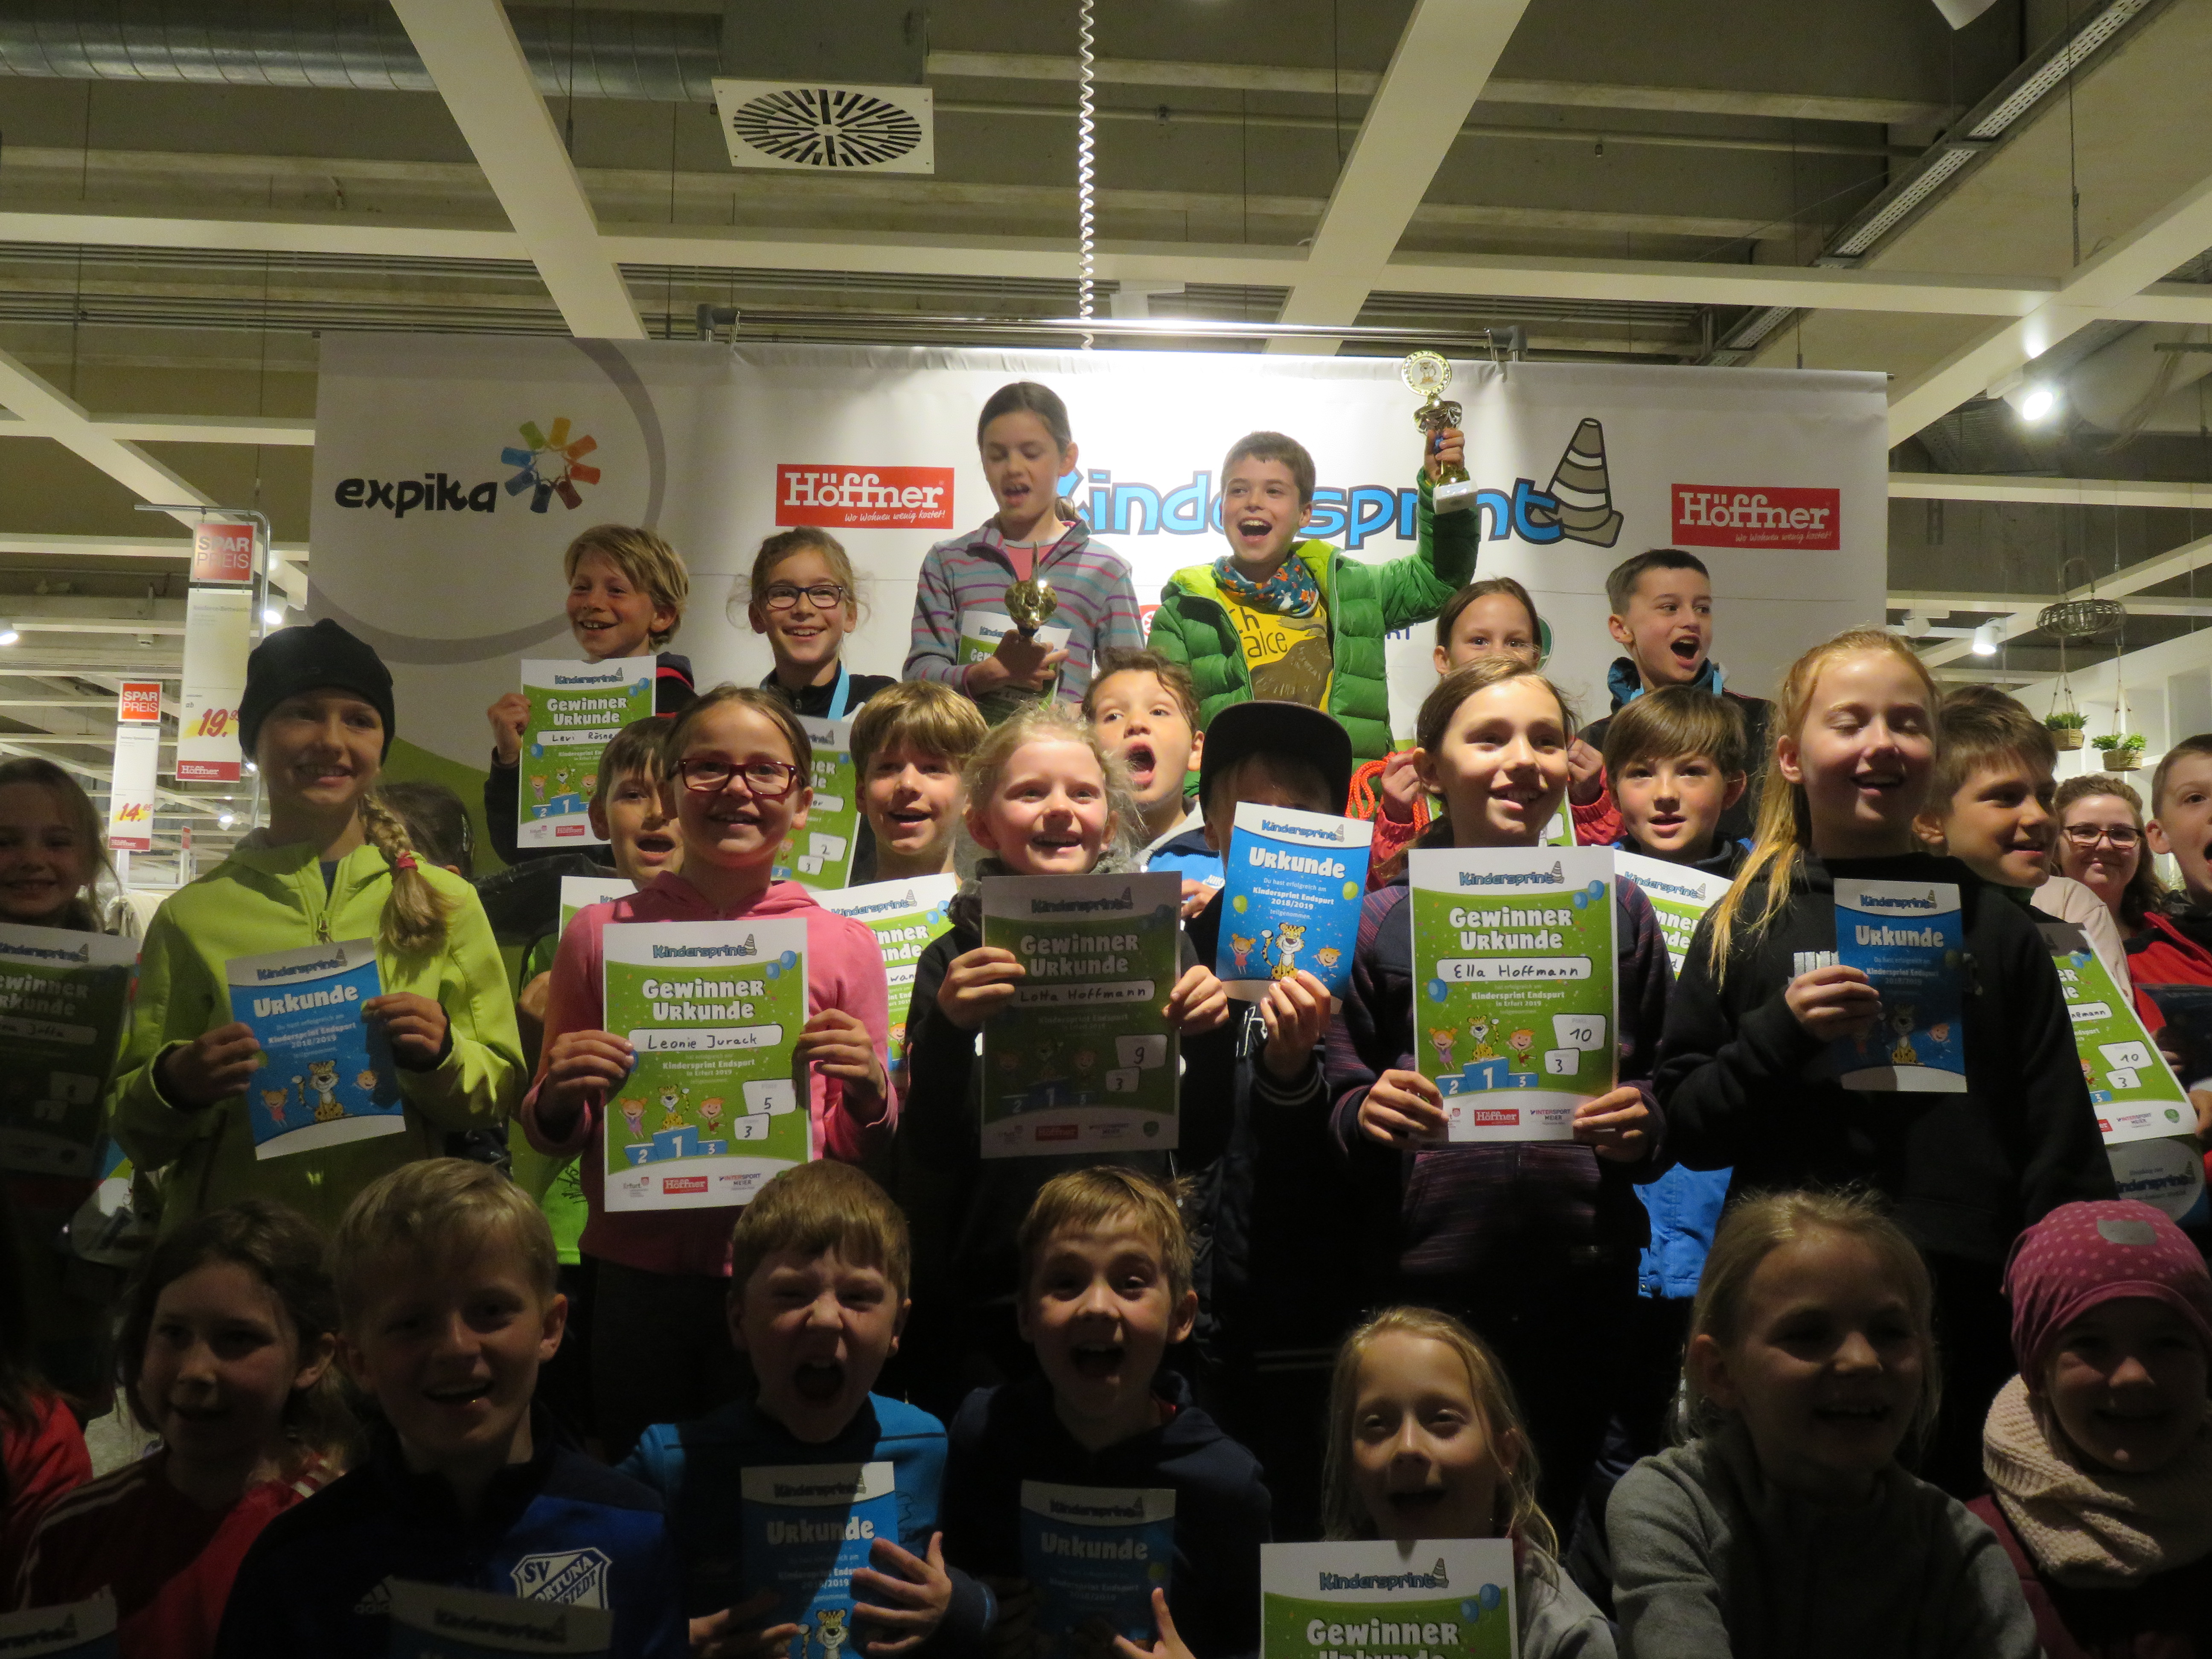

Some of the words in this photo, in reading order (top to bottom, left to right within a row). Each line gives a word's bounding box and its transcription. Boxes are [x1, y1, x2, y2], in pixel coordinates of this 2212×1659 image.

[335, 473, 498, 518] expika
[784, 473, 943, 508] Höffner
[860, 512, 891, 521] Wohnen
[894, 510, 916, 523] wenig
[918, 509, 945, 519] kostet!
[1679, 492, 1830, 529] Höffner
[199, 536, 250, 552] SPAR
[197, 552, 249, 568] PREIS
[124, 691, 157, 701] SPAR
[123, 702, 157, 713] PREIS
[540, 807, 547, 818] 2
[562, 799, 570, 813] 1
[1262, 820, 1336, 841] Kindersprint
[1249, 847, 1345, 879] Urkunde
[1286, 881, 1316, 891] erfolgreich
[1459, 872, 1554, 886] Kindersprint
[1253, 887, 1300, 900] Kindersprint
[1301, 894, 1334, 905] Endspurt
[1271, 898, 1314, 910] 2018/2019
[1449, 906, 1573, 928] Gewinner
[875, 924, 928, 945] inner
[1461, 929, 1563, 950] Urkunde
[1855, 925, 1944, 948] Urkunde
[653, 944, 747, 959] Kindersprint
[1454, 964, 1486, 978] Ella
[1498, 964, 1578, 978] Hoffmann
[643, 978, 765, 998] Gewinner
[1472, 992, 1525, 1000] Kindersprint
[1528, 991, 1565, 1000] Endspurt
[253, 984, 359, 1018] Urkunde
[653, 1000, 755, 1022] Urkunde
[648, 1035, 696, 1049] Leonie
[1570, 1028, 1592, 1042] 10
[1134, 1047, 1144, 1064] 9
[2119, 1053, 2139, 1062] 10
[663, 1061, 716, 1070] Kindersprint
[719, 1059, 755, 1068] Endspurt
[1556, 1059, 1563, 1073] 3
[1483, 1067, 1493, 1089] 1
[1519, 1076, 1527, 1088] 3
[2118, 1077, 2127, 1088] 3
[1449, 1080, 1459, 1095] 2
[764, 1097, 772, 1110] 5
[1046, 1087, 1055, 1106] 1
[2096, 1094, 2103, 1102] 3
[1013, 1100, 1022, 1113] 2
[1476, 1110, 1517, 1121] Höffner
[744, 1126, 752, 1138] 3
[672, 1136, 683, 1158] 1
[708, 1144, 716, 1155] 3
[638, 1149, 648, 1164] 2
[665, 1178, 706, 1189] Höffner
[767, 1516, 875, 1545] Urkunde
[524, 1560, 550, 1583] SV
[535, 1554, 594, 1601] ORTUNA
[556, 1569, 596, 1604] STEDT
[1319, 1571, 1435, 1591] Kindersprint
[1307, 1617, 1460, 1647] Gewinner
